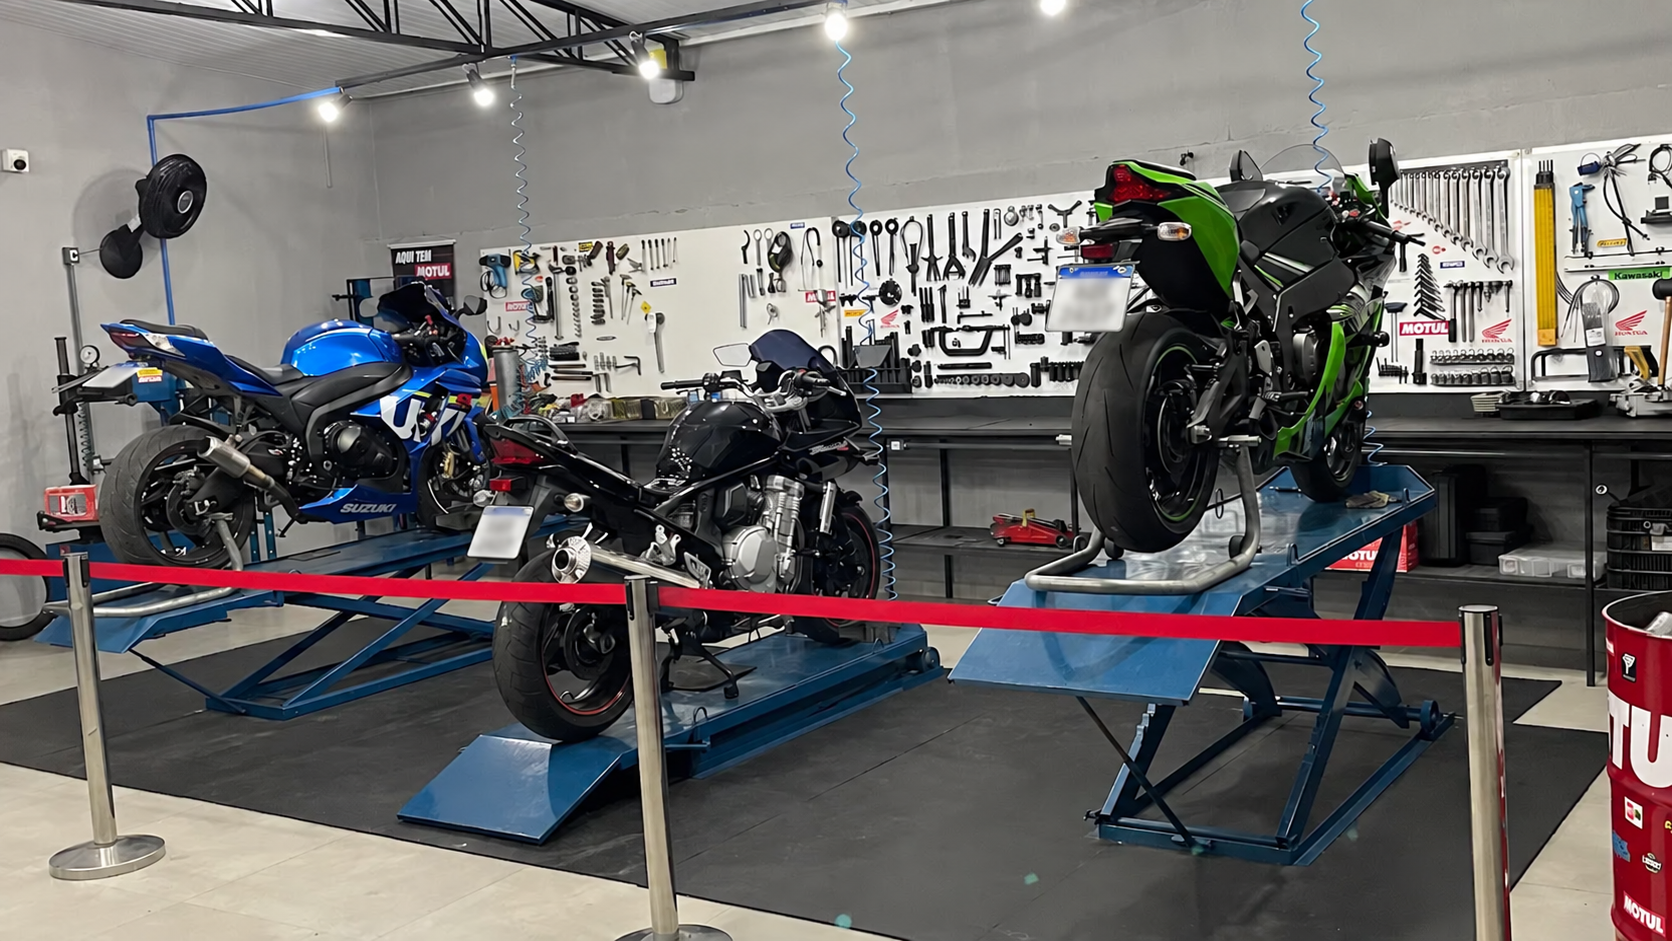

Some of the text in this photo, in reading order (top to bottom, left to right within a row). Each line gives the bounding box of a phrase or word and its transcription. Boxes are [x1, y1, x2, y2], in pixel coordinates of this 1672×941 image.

[395, 249, 432, 264] AQUI TEM
[416, 265, 450, 278] MOTUL
[1614, 270, 1663, 280] Kawasaki
[1401, 322, 1448, 334] MOTUL
[339, 503, 397, 514] SUZUKI
[1342, 550, 1379, 561] OTU
[1623, 895, 1664, 934] MOTUL
